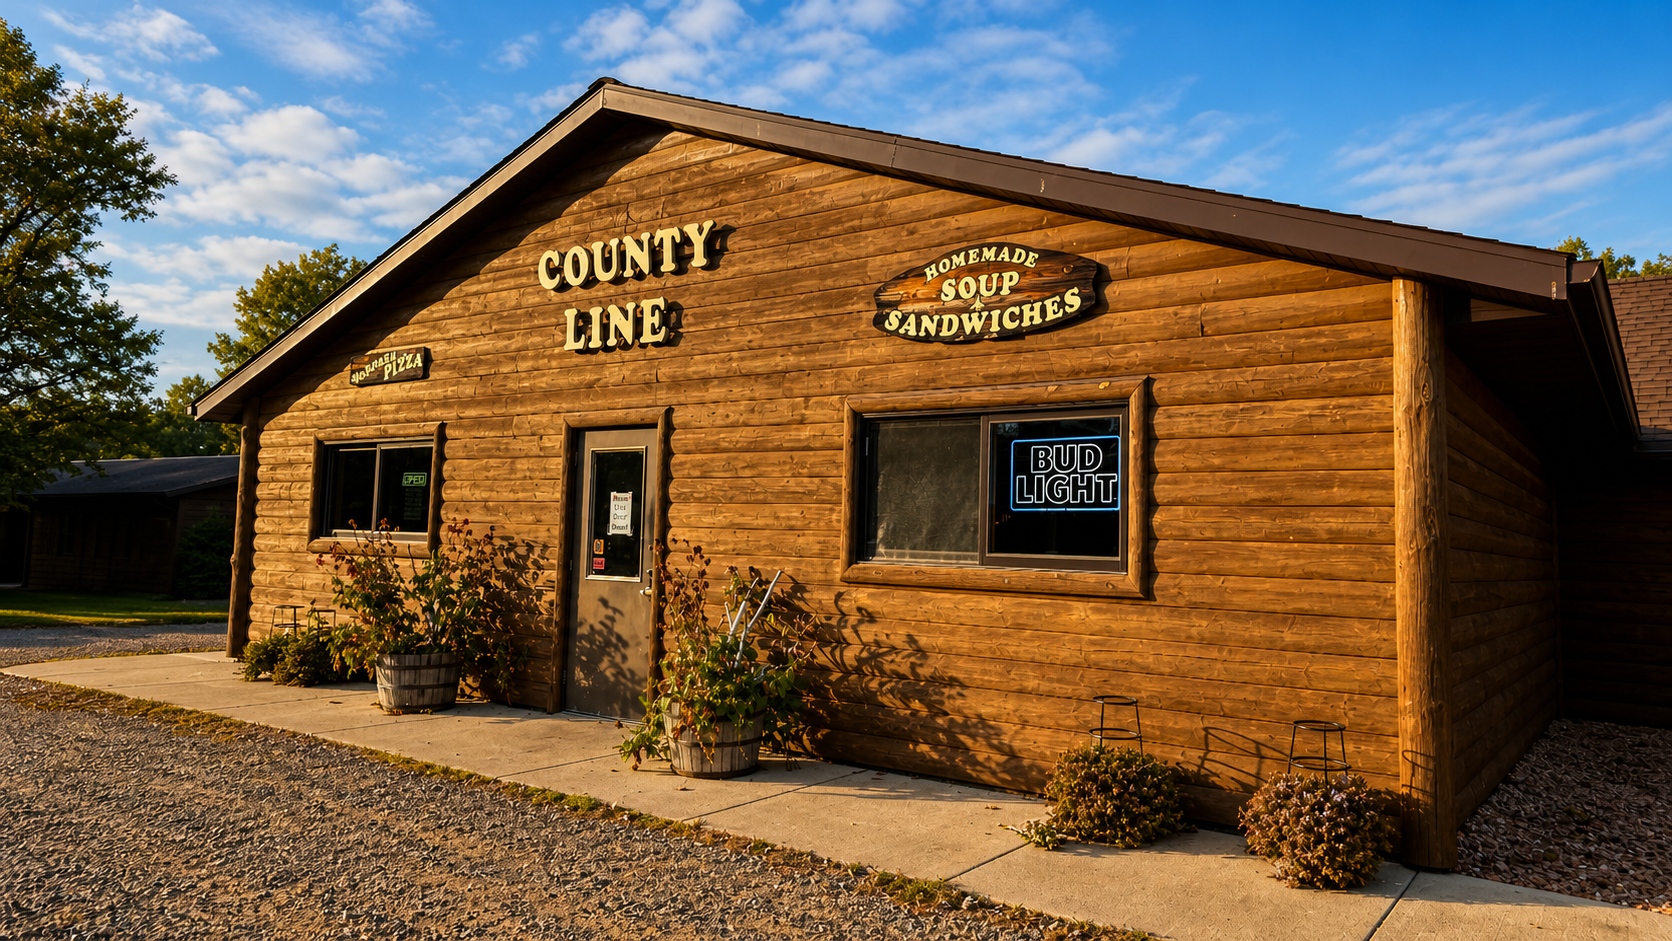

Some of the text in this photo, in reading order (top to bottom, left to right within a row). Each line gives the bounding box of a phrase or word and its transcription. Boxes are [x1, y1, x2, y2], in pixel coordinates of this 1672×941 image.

[538, 220, 716, 290] COUNTY
[924, 246, 1039, 282] HOMEMADE
[940, 271, 1020, 301] SOUP
[564, 296, 669, 350] LINE
[884, 287, 1082, 337] SANDWICHES
[383, 353, 423, 381] PIZZA
[1031, 443, 1103, 474] BUD
[1016, 473, 1118, 505] LIGHT
